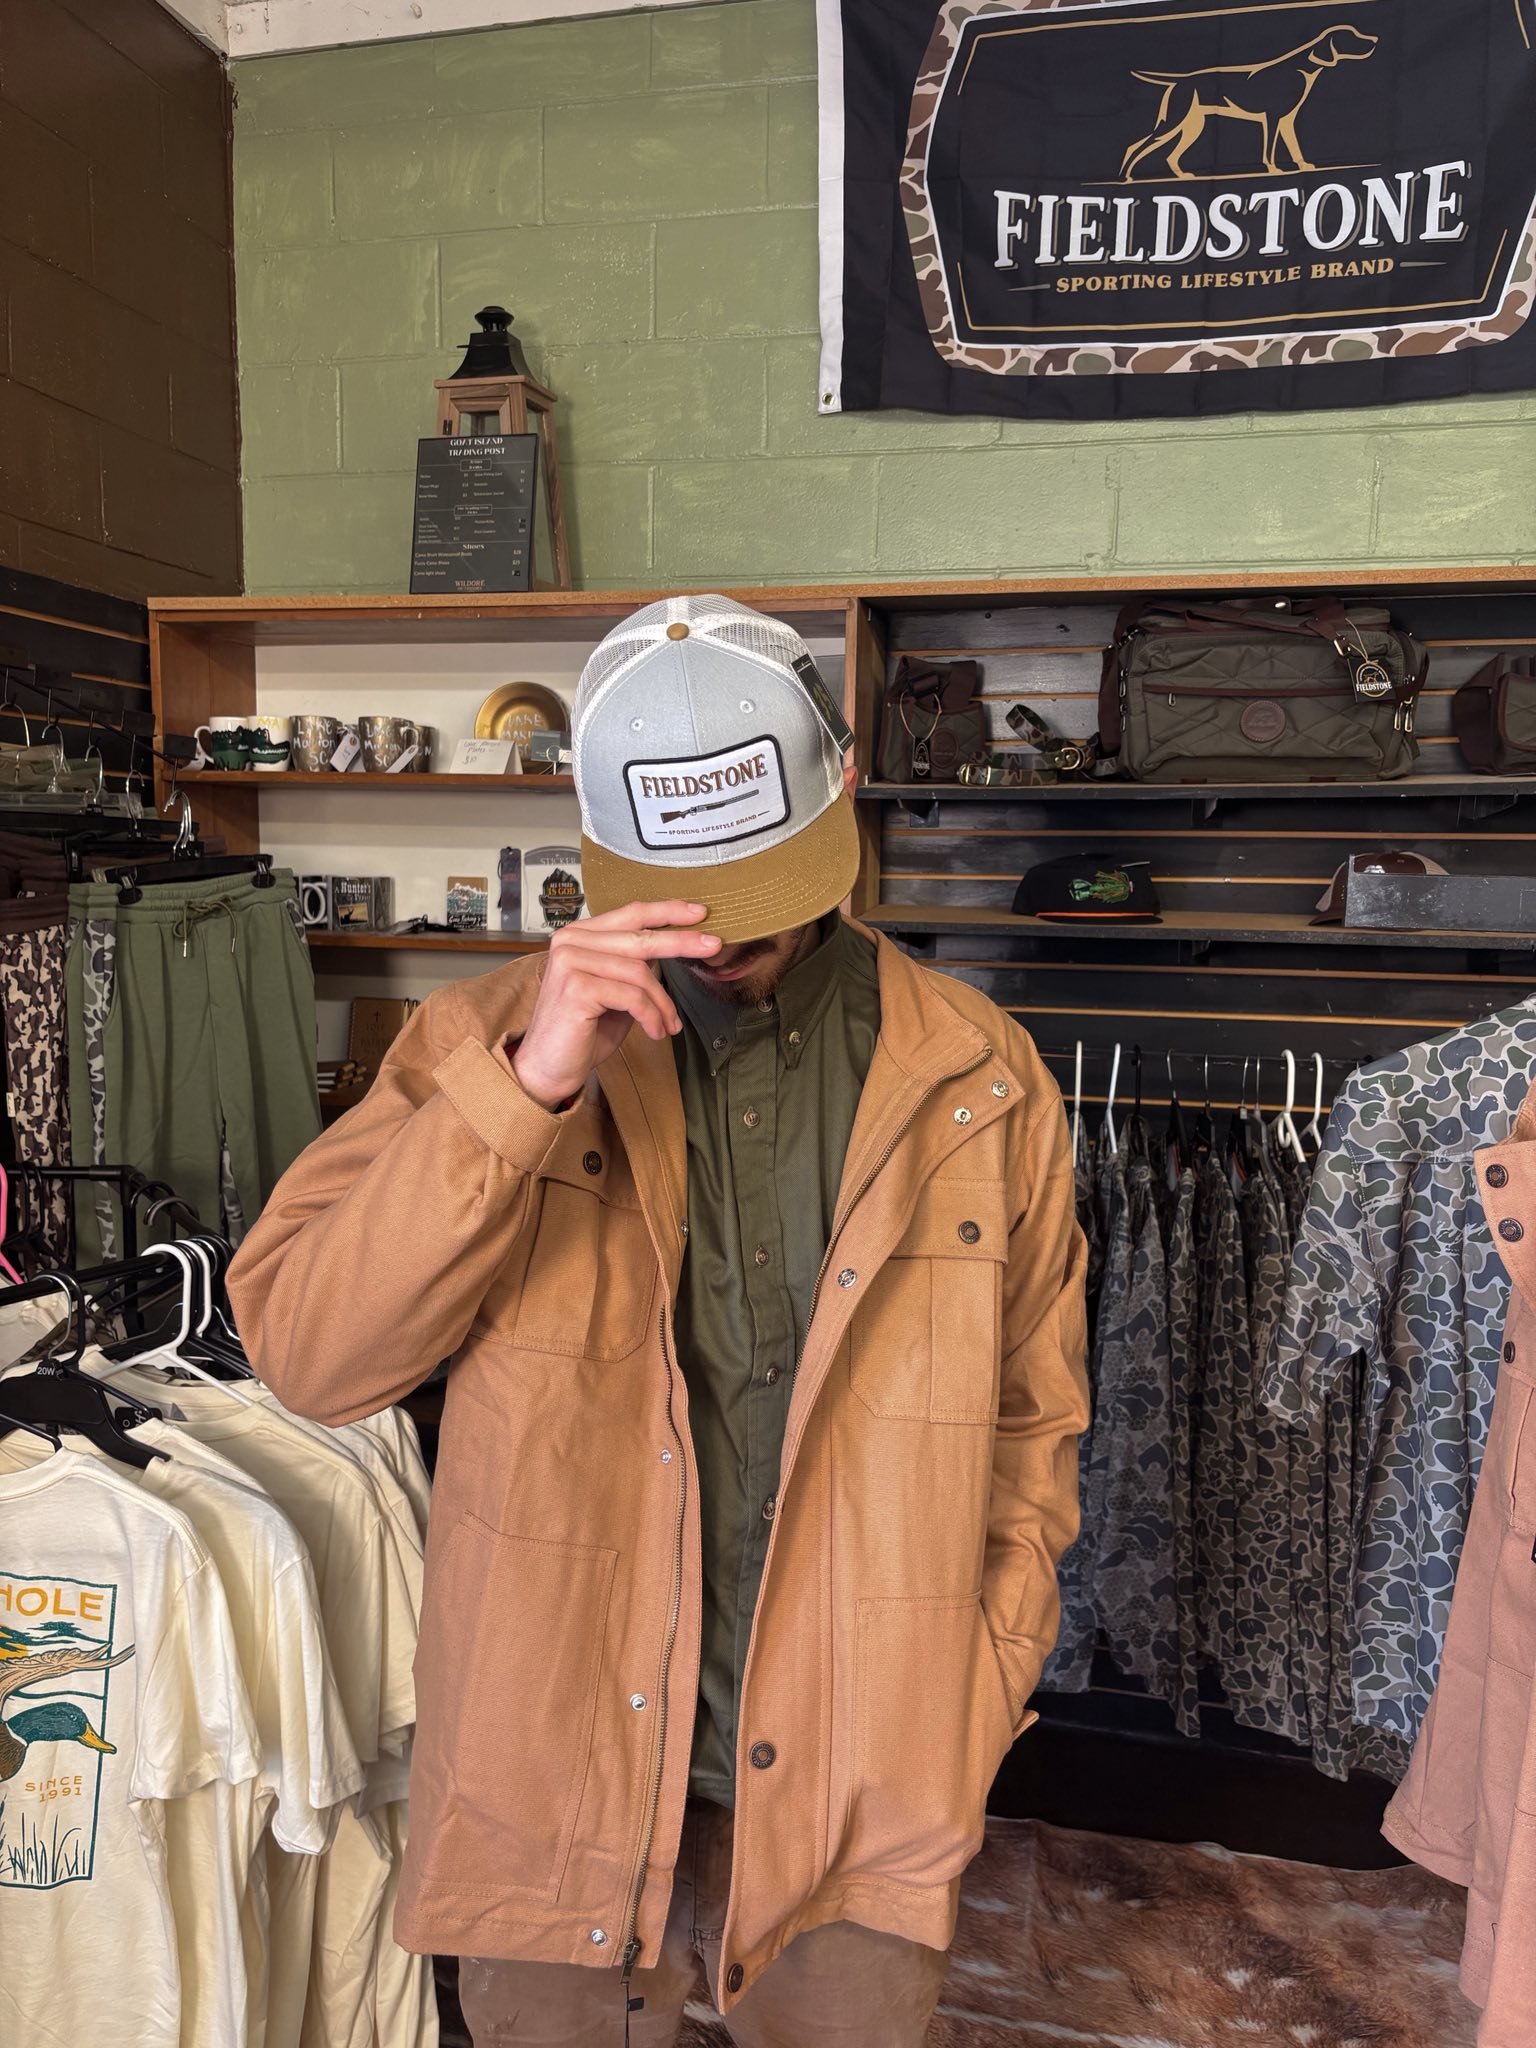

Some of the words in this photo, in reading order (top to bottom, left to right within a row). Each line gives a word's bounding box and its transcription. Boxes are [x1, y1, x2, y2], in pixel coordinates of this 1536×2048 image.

[994, 160, 1470, 269] FIELDSTONE
[1055, 273, 1172, 294] SPORTING
[1180, 265, 1302, 290] LIFESTYLE
[1309, 257, 1395, 280] BRAND
[484, 447, 506, 455] POST
[1355, 681, 1393, 692] FIELDSTONE
[640, 753, 769, 799] FIELDSTONE
[668, 828, 700, 836] SPORTING
[701, 822, 735, 833] LIFESTYLE
[735, 814, 757, 826] BRAND
[25, 1775, 82, 1792] SINCE
[39, 1786, 82, 1802] 1991
